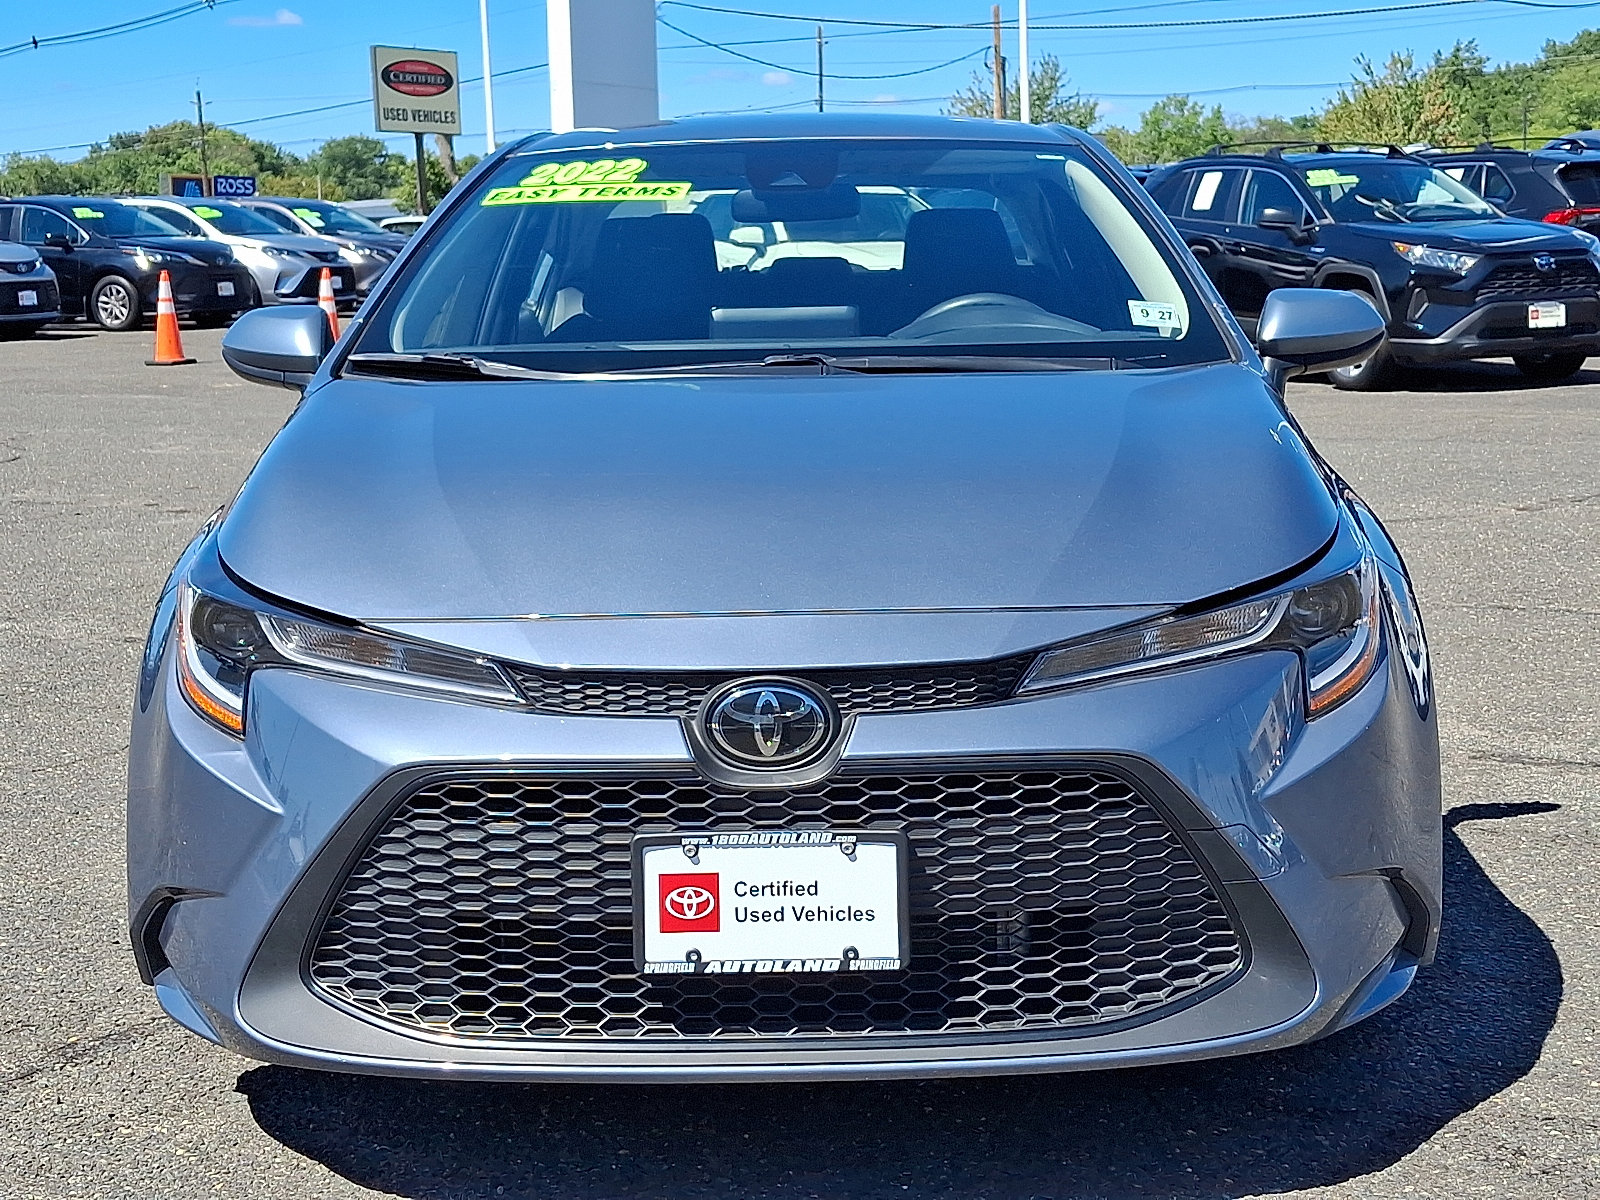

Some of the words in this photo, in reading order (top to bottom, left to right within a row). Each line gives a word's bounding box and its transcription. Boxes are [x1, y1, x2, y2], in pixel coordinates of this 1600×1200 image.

[389, 71, 446, 84] CERTIFIED
[383, 107, 409, 121] USED
[411, 109, 456, 124] VEHICLES
[519, 157, 649, 187] 2022
[217, 178, 254, 194] ROSS
[487, 188, 569, 202] EASY
[578, 186, 681, 198] TERMS
[1141, 308, 1150, 318] 9
[1158, 310, 1173, 320] 27
[734, 880, 819, 897] Certified
[734, 906, 785, 923] Used
[792, 906, 876, 922] Vehicles
[644, 962, 696, 974] SPRINGFIELD
[703, 959, 841, 973] AUTOLAND
[849, 959, 901, 971] SPRINGFIELD
